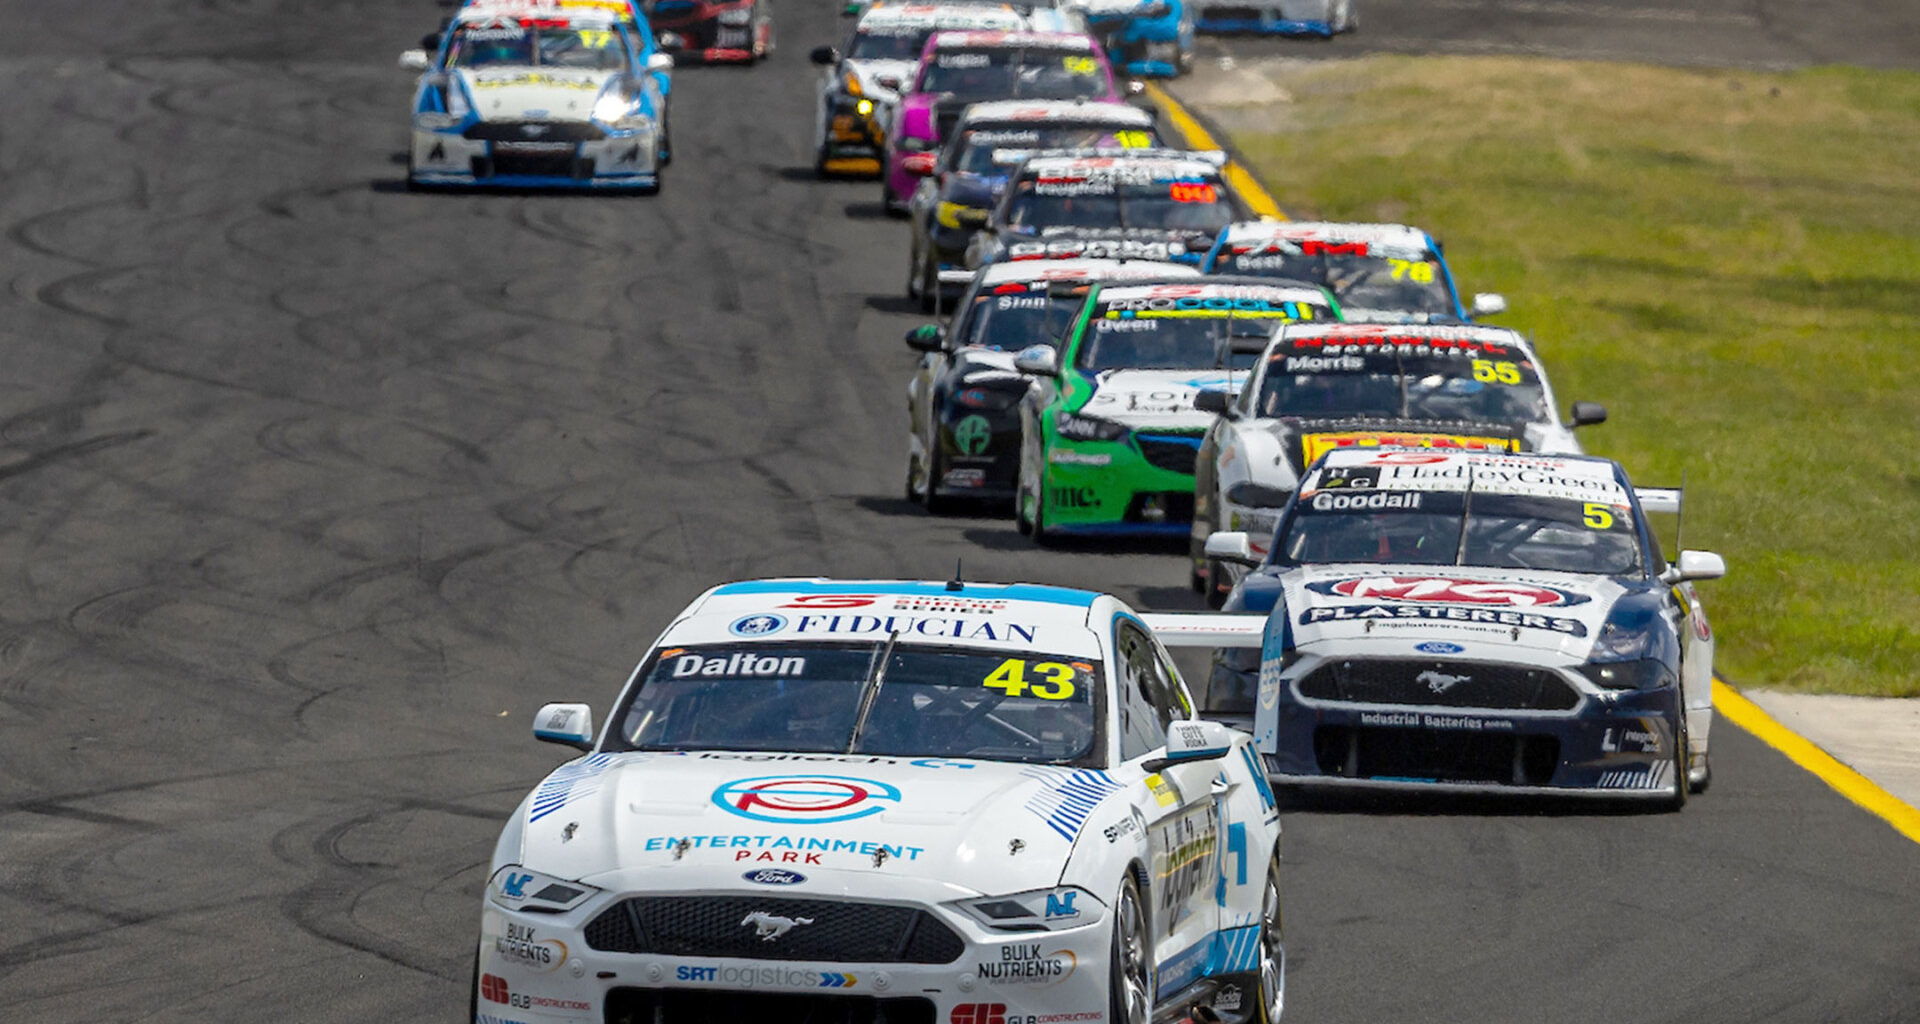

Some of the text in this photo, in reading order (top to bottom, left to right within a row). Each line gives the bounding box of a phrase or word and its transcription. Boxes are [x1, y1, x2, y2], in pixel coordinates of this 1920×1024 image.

[998, 295, 1046, 311] Sinn
[1286, 354, 1365, 373] Morris
[1472, 359, 1521, 384] 55
[1312, 491, 1421, 511] Goodall
[1583, 502, 1613, 530] 5
[796, 614, 1040, 643] FIDUCIAN
[1310, 606, 1576, 633] PLASTERERS
[673, 653, 805, 679] Dalton
[983, 658, 1076, 700] 43
[1361, 713, 1420, 726] Industrial
[1424, 716, 1482, 729] Batteries
[645, 834, 925, 861] ENTERTAINMENT
[735, 850, 823, 865] PARK
[753, 871, 796, 885] Ford
[508, 923, 536, 943] BULK
[495, 937, 551, 963] NUTRIENTS
[1002, 944, 1042, 961] BULK
[978, 960, 1062, 979] NUTRIENTS
[511, 992, 530, 1009] GLB
